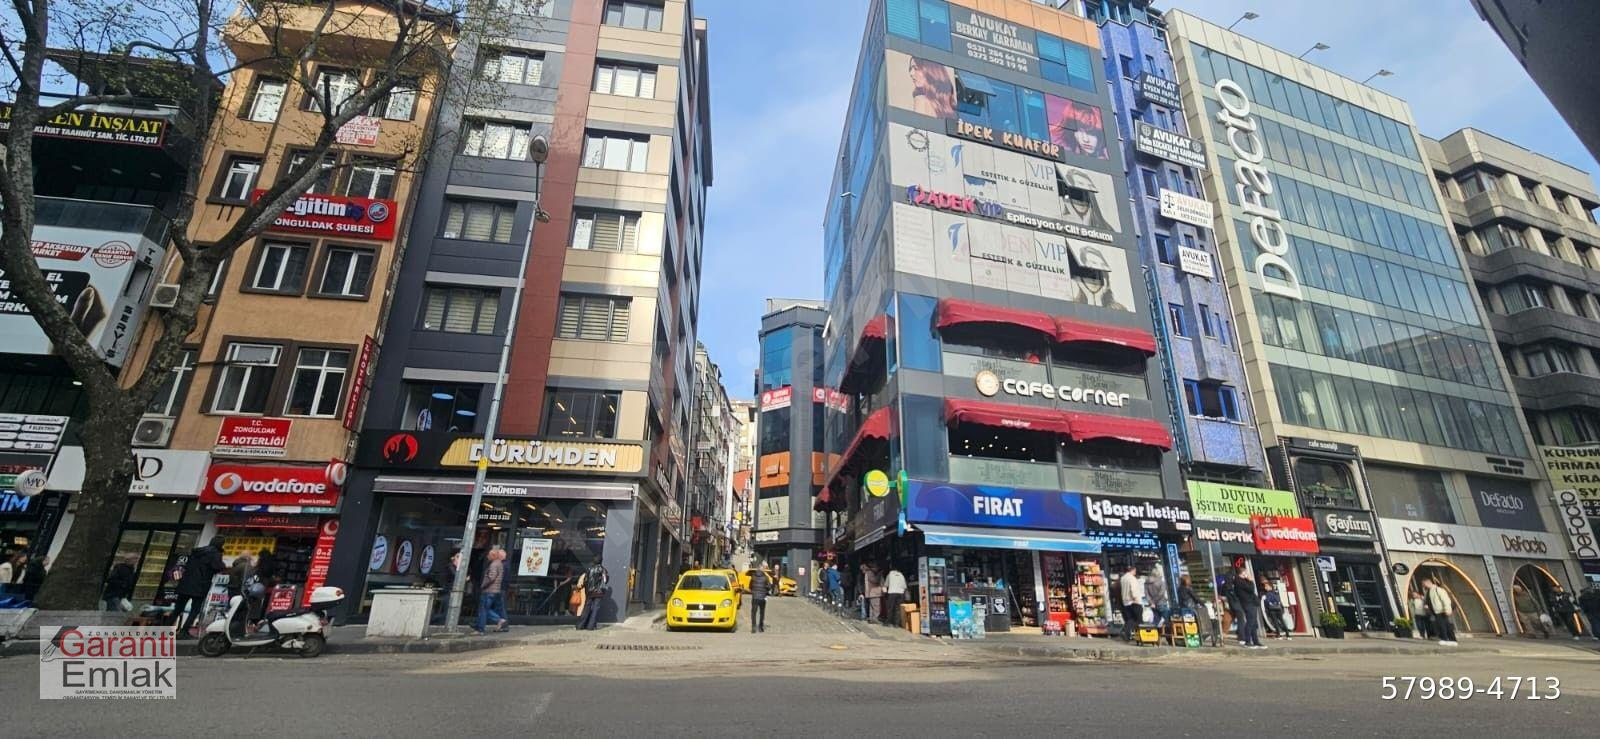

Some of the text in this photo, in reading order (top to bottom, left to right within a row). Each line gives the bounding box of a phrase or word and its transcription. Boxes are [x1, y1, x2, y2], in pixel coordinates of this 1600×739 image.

[970, 14, 1017, 38] AVUKAT
[955, 21, 1034, 54] BERKAY KARAMAN
[1146, 74, 1176, 92] AVUKAT
[90, 112, 162, 134] İNŞAAT
[957, 118, 1060, 158] İPEK KUAFÖR
[1153, 129, 1191, 150] AVUKAT
[1026, 158, 1054, 181] VIP
[1018, 178, 1054, 192] GÜZELLİK
[1214, 78, 1303, 300] DeFacto
[274, 218, 374, 234] ONGULDAK ŞUBESİ
[1006, 212, 1056, 231] Epilasyon
[43, 242, 88, 253] AKSESUAR
[1035, 238, 1066, 262] VIP
[1182, 249, 1208, 264] AVUKAT
[1025, 260, 1066, 275] GÜZELLİK
[234, 426, 276, 434] ZONGULDAK
[219, 436, 285, 446] 2. NOTERLİĞİ
[470, 439, 618, 468] DÜRÜMDEN
[242, 478, 326, 494] vodafone
[1220, 488, 1267, 504] DUYUM
[973, 496, 1024, 517] FIRAT
[1101, 499, 1144, 520] Başar
[1480, 490, 1524, 510] DeFacto
[1270, 527, 1317, 542] vodafone
[1560, 491, 1598, 558] DeFacto
[1402, 526, 1456, 548] DeFacto
[1501, 534, 1548, 554] DeFacto
